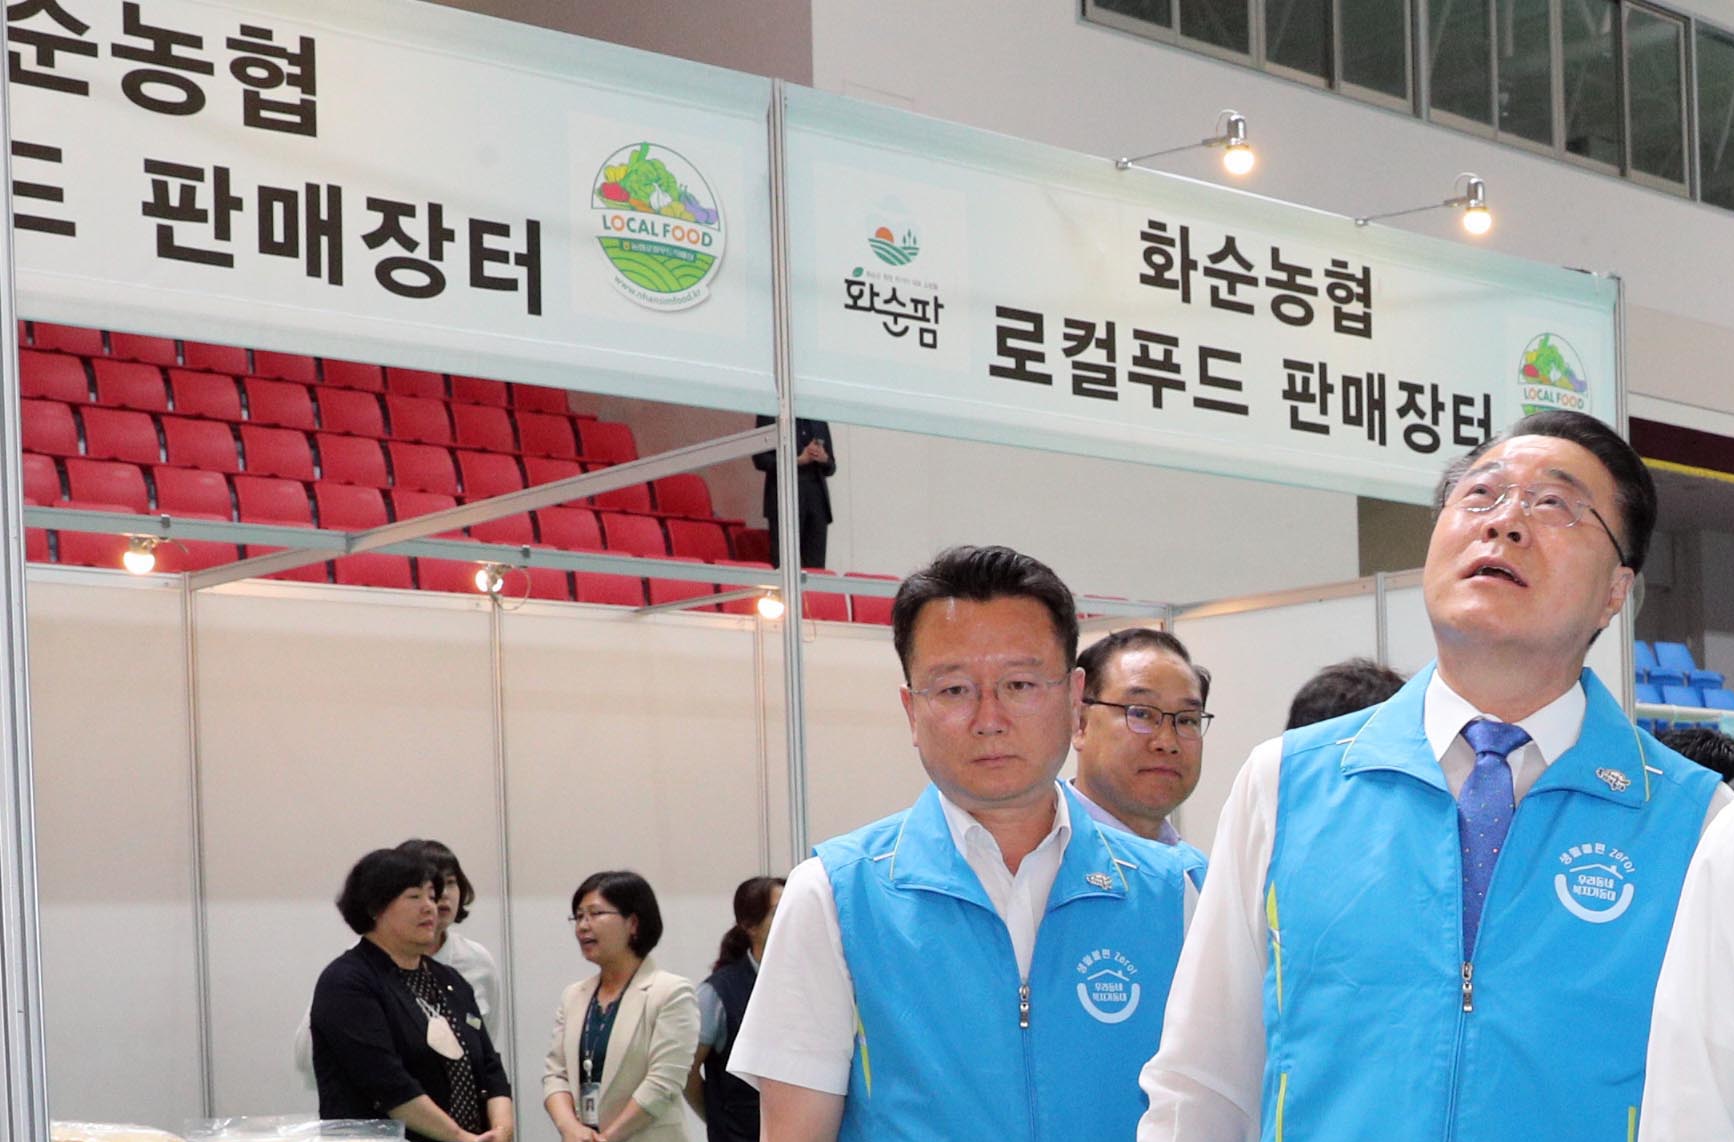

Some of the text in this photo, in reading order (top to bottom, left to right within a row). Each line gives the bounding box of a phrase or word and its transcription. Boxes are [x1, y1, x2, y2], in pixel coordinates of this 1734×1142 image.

[141, 158, 543, 316] 판매장터
[602, 214, 713, 247] LOCAL FOOD
[1138, 218, 1373, 339] 화순농협
[844, 278, 944, 349] 화순팜
[989, 305, 1493, 456] 로컬푸드 판매장터
[1523, 387, 1584, 409] LOCAL FOOD
